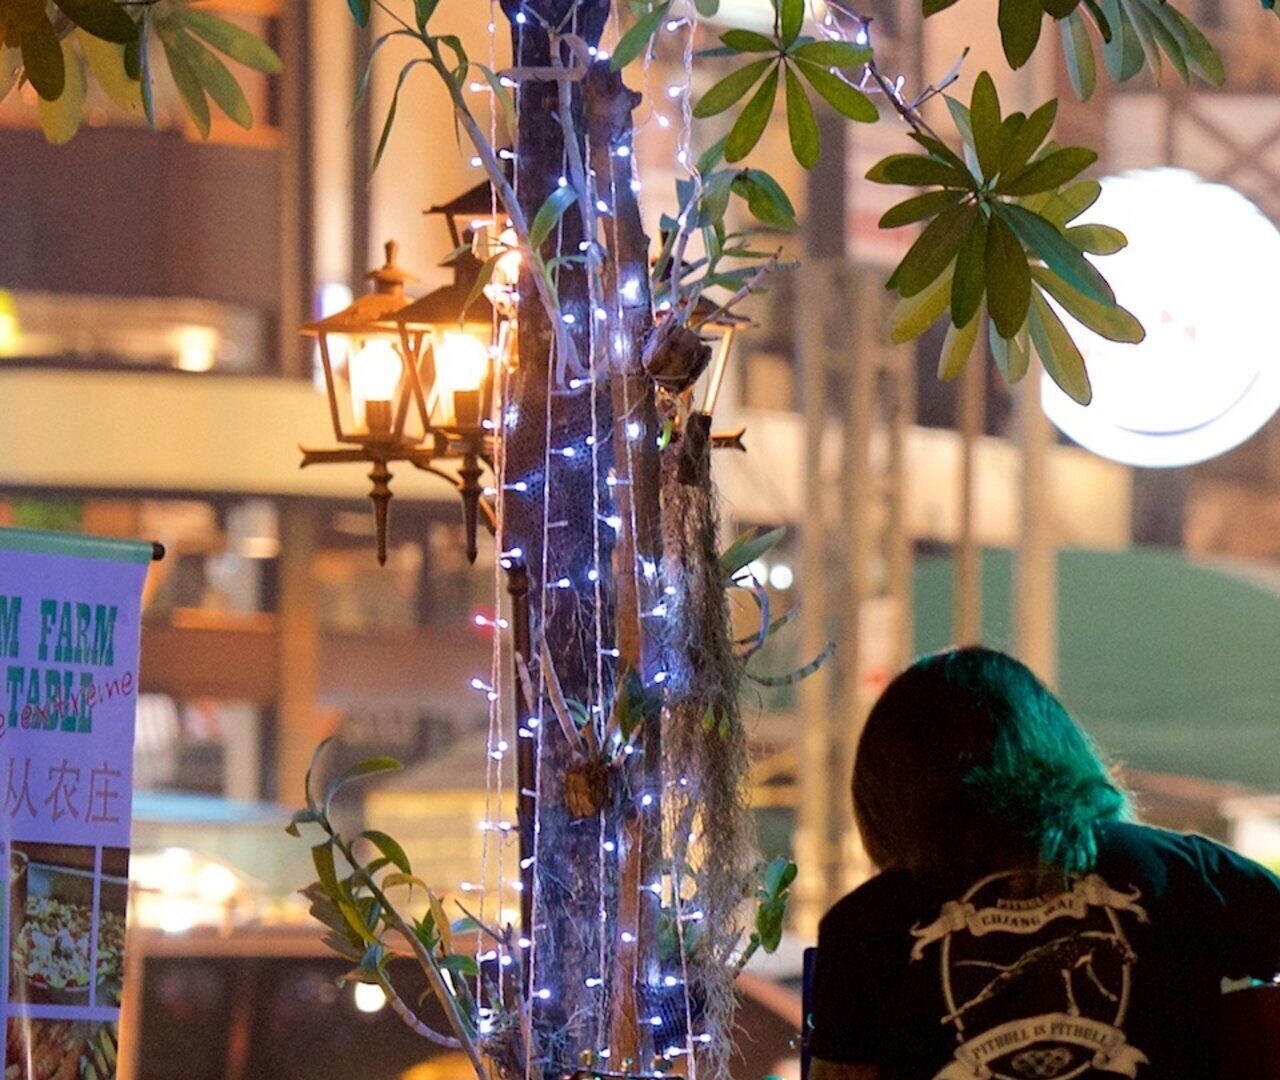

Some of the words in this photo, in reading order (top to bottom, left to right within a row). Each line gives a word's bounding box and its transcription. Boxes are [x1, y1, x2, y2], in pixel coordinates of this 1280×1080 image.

[38, 597, 118, 667] FARM
[6, 665, 93, 734] TABLE
[2, 757, 121, 824] 从农庄
[971, 1028, 1031, 1060] PITBULL
[1050, 1021, 1107, 1045] PITBULL
